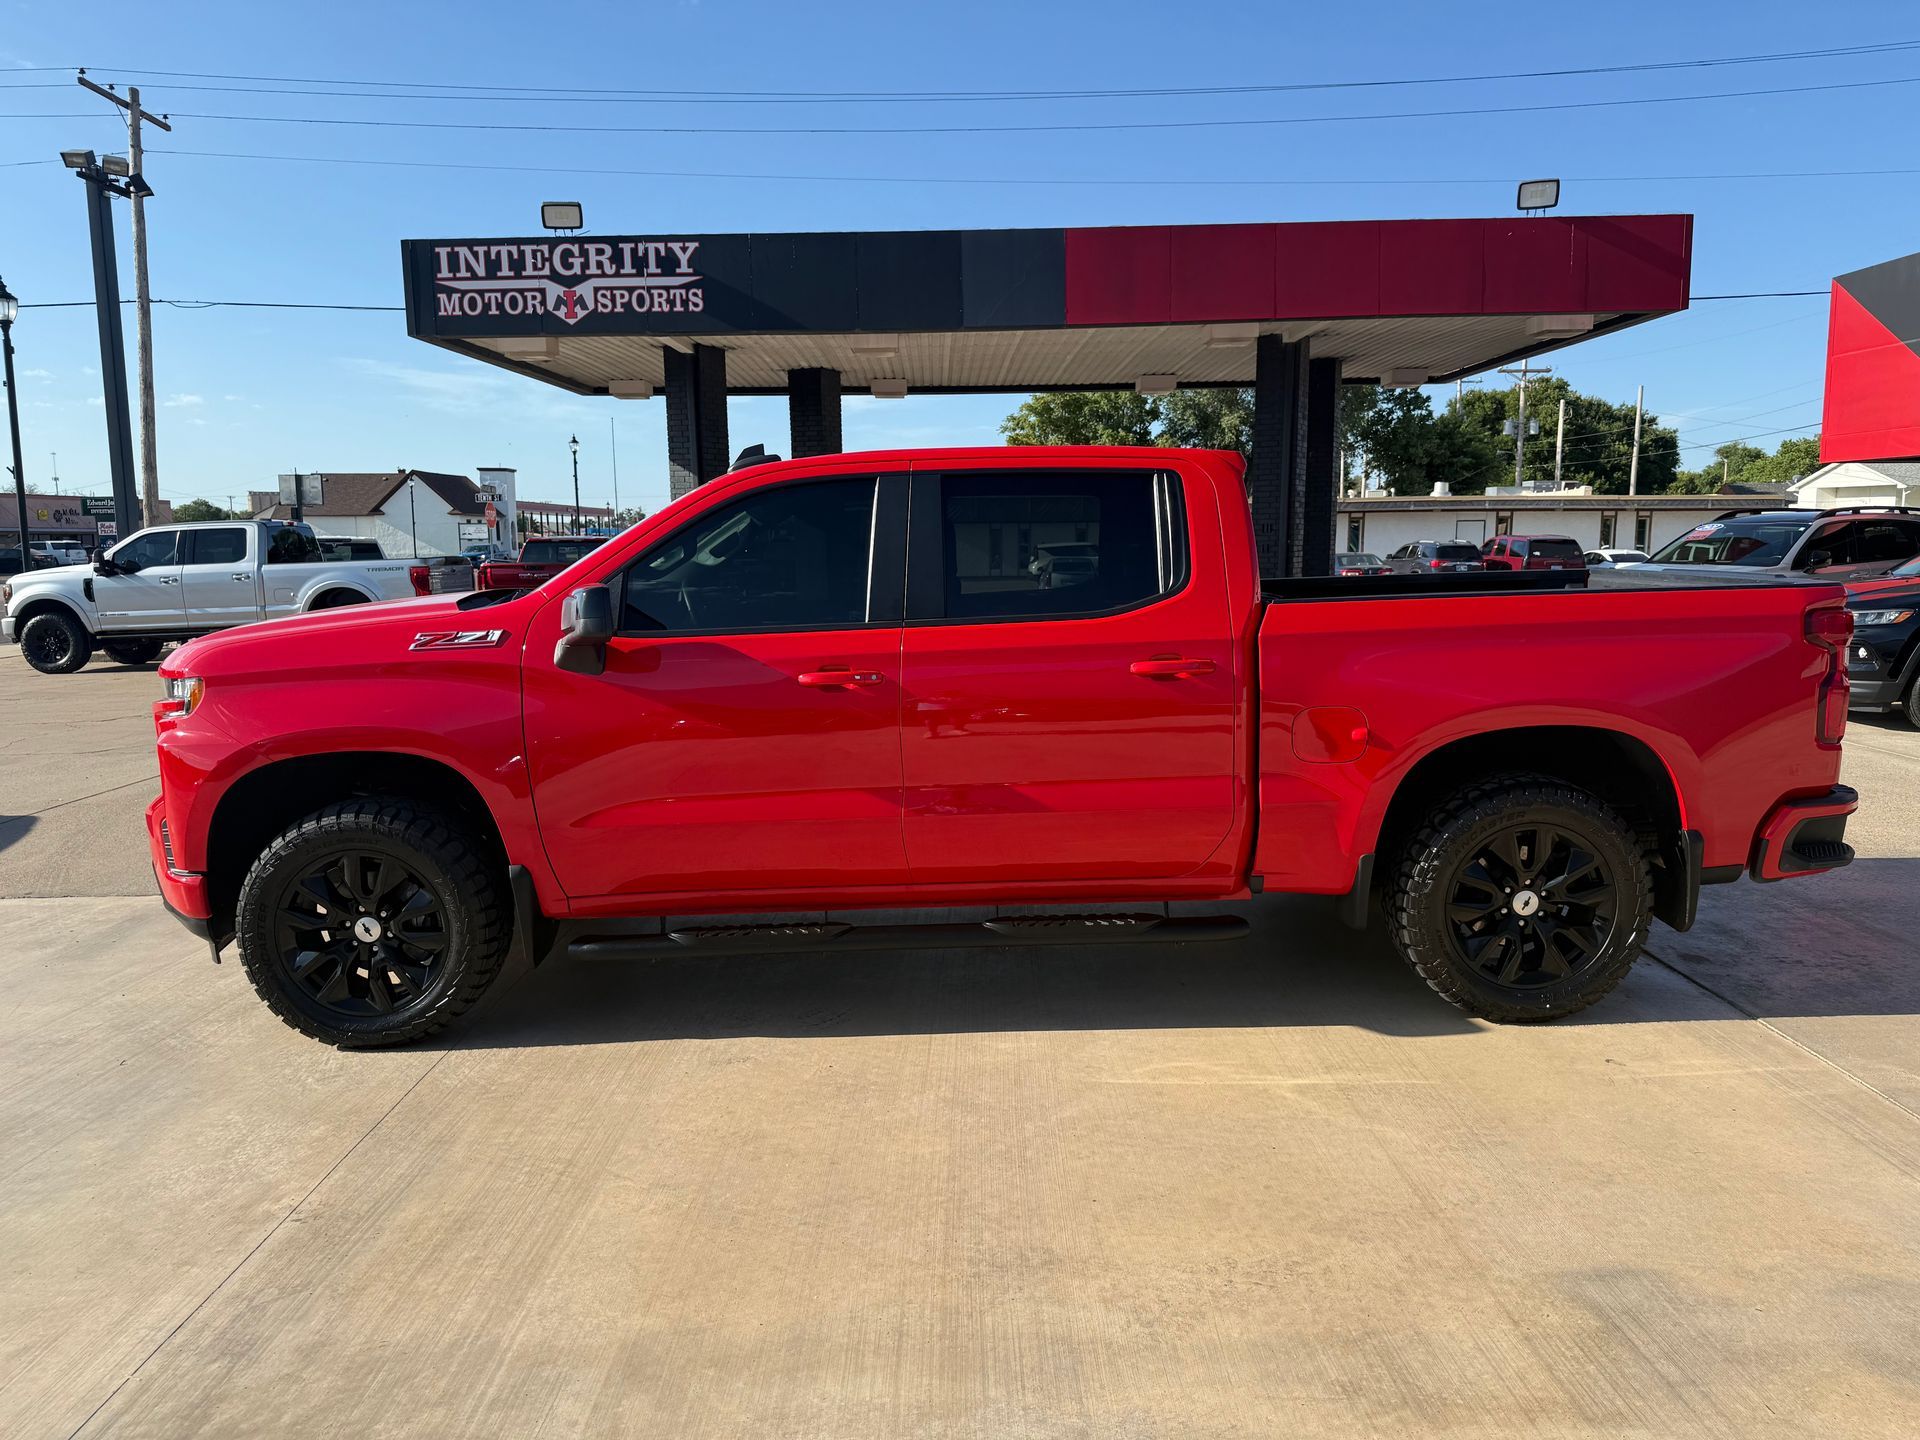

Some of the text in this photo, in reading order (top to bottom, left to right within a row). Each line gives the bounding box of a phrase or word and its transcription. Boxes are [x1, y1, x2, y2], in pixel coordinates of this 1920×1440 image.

[434, 241, 701, 279] INTEGRITY
[437, 288, 704, 316] MOTOR SPORTS
[408, 629, 505, 651] Z71
